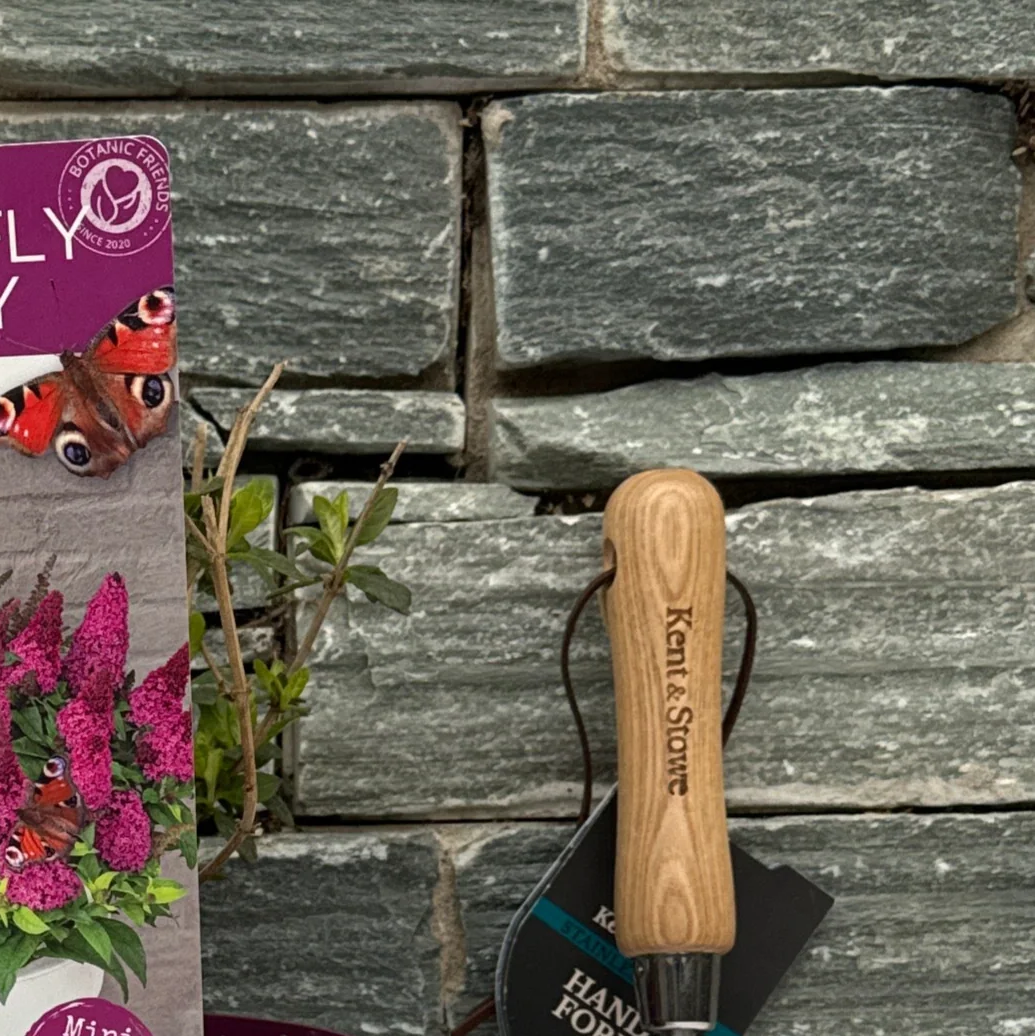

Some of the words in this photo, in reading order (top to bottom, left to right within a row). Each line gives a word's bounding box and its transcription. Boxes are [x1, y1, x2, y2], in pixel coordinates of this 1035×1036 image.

[68, 140, 135, 178] BOTANIC
[136, 147, 170, 212] FRIENDS
[76, 222, 103, 247] SINCE
[105, 238, 131, 249] 2020
[666, 606, 693, 679] Kent
[666, 682, 686, 701] &
[666, 706, 694, 796] Stowe
